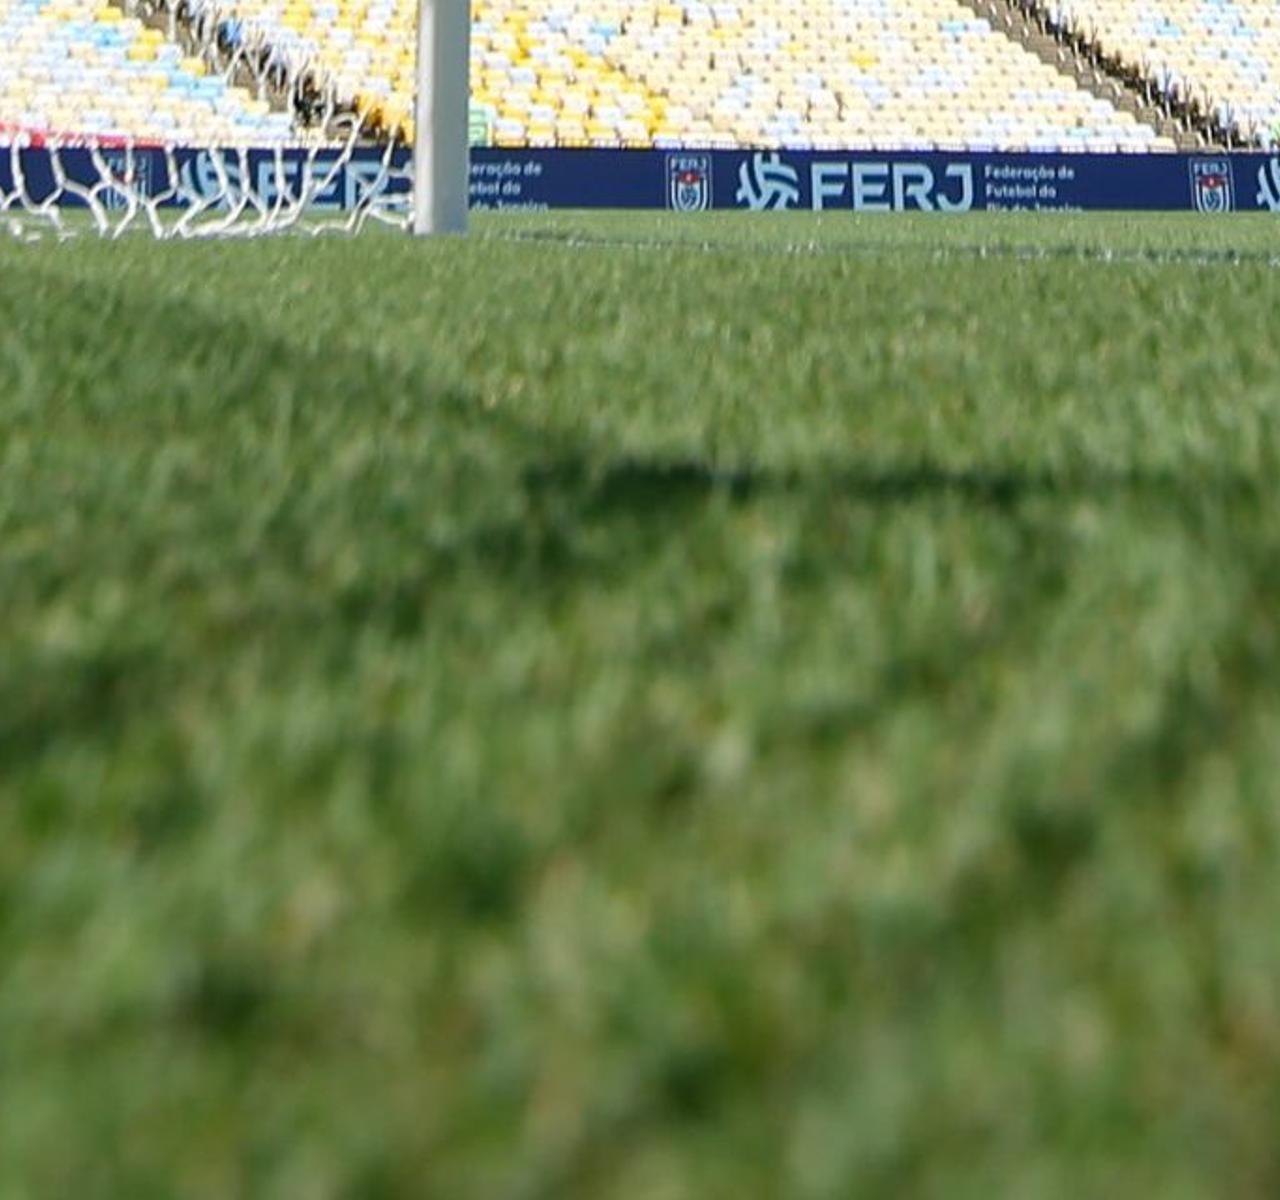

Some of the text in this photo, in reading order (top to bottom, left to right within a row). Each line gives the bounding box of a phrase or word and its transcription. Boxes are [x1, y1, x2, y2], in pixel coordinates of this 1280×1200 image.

[984, 164, 1075, 183] Federação de
[811, 162, 973, 211] FERJ
[986, 183, 1057, 198] Futebol do
